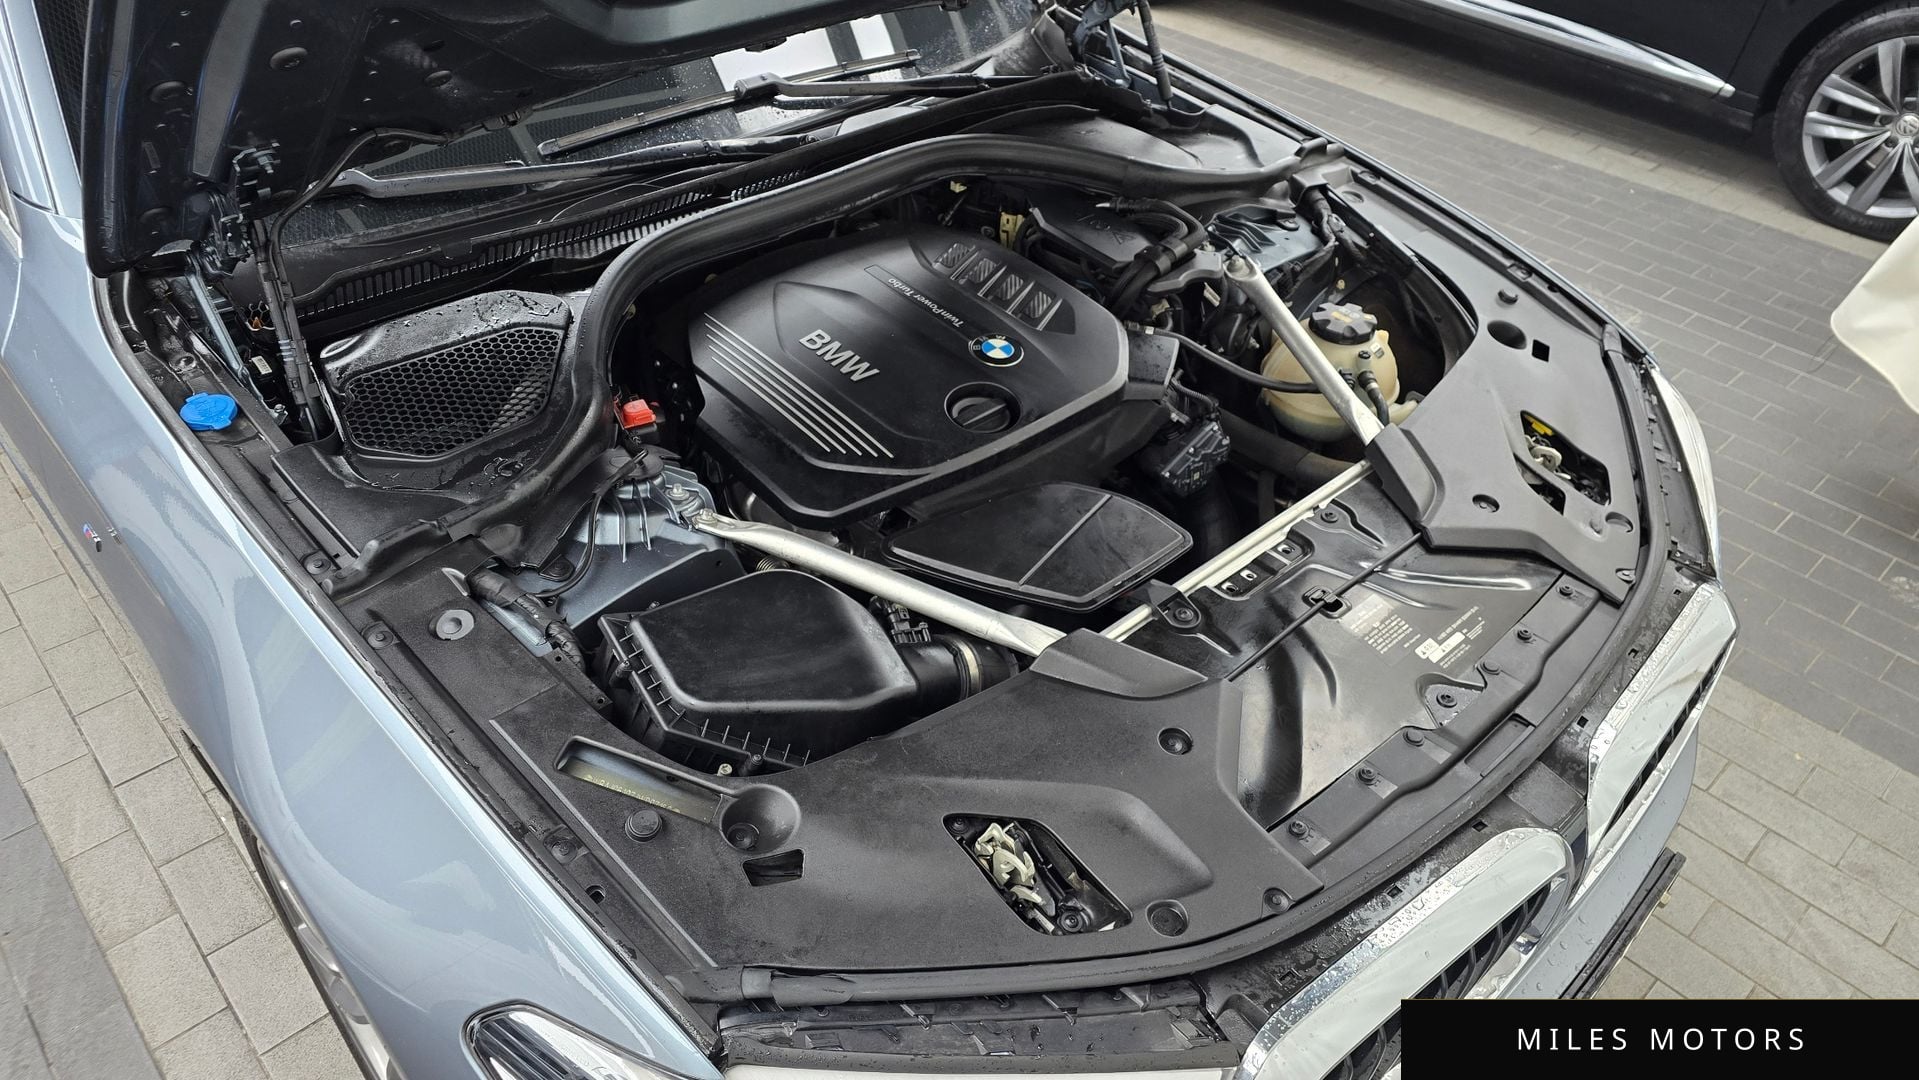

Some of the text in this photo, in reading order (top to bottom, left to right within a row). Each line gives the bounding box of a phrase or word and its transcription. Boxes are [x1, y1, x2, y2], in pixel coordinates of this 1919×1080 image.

[888, 278, 964, 328] TwinPower Turbo
[799, 329, 881, 382] BMW
